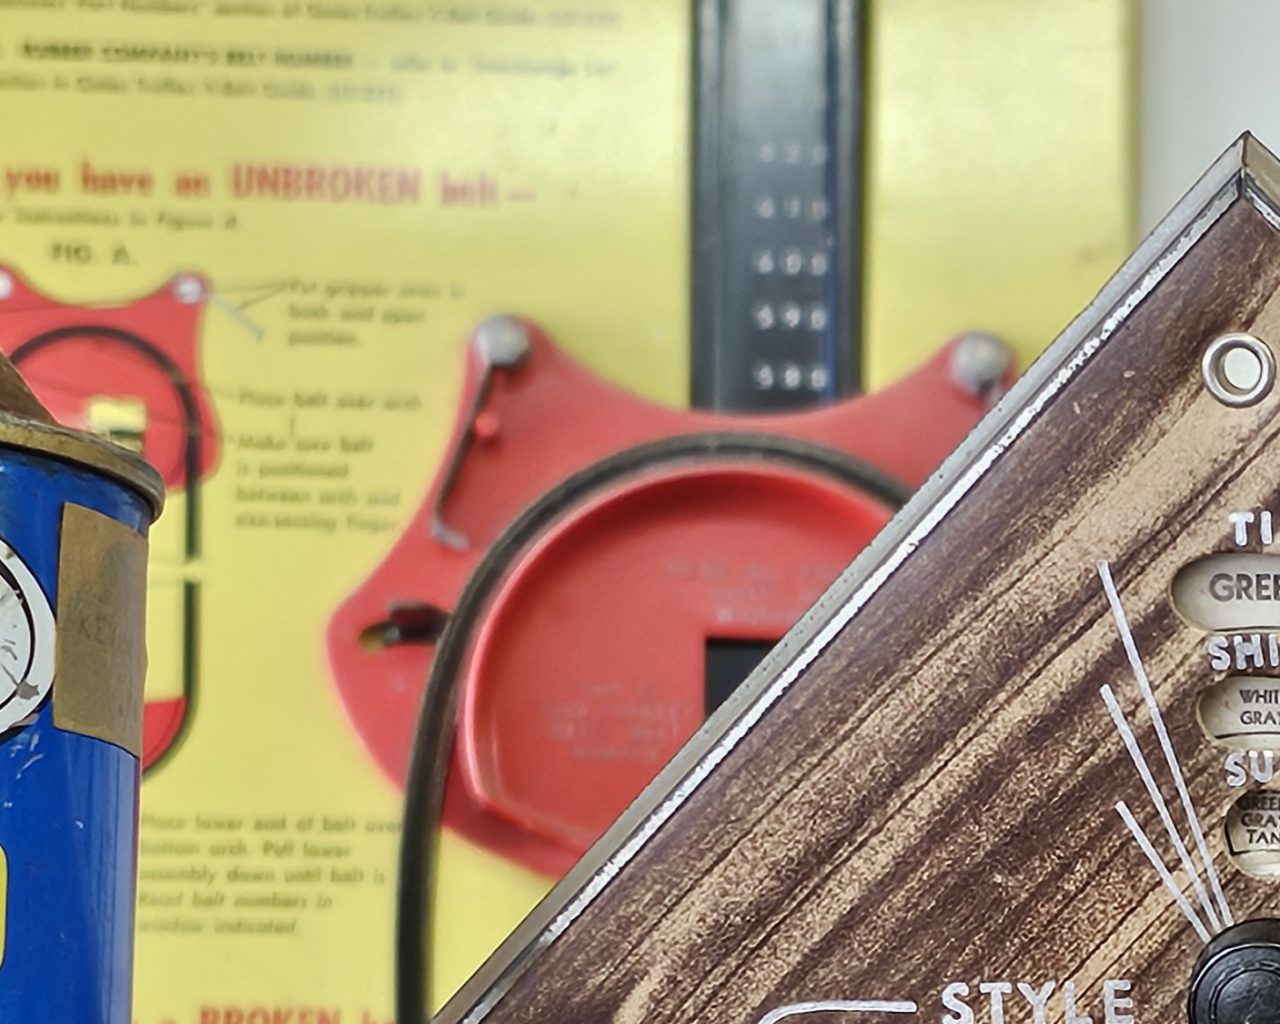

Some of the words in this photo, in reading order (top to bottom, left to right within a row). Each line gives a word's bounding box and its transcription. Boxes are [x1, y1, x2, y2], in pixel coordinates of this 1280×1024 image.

[5, 168, 60, 201] you
[81, 158, 152, 197] have
[232, 163, 421, 204] UNBROKEN
